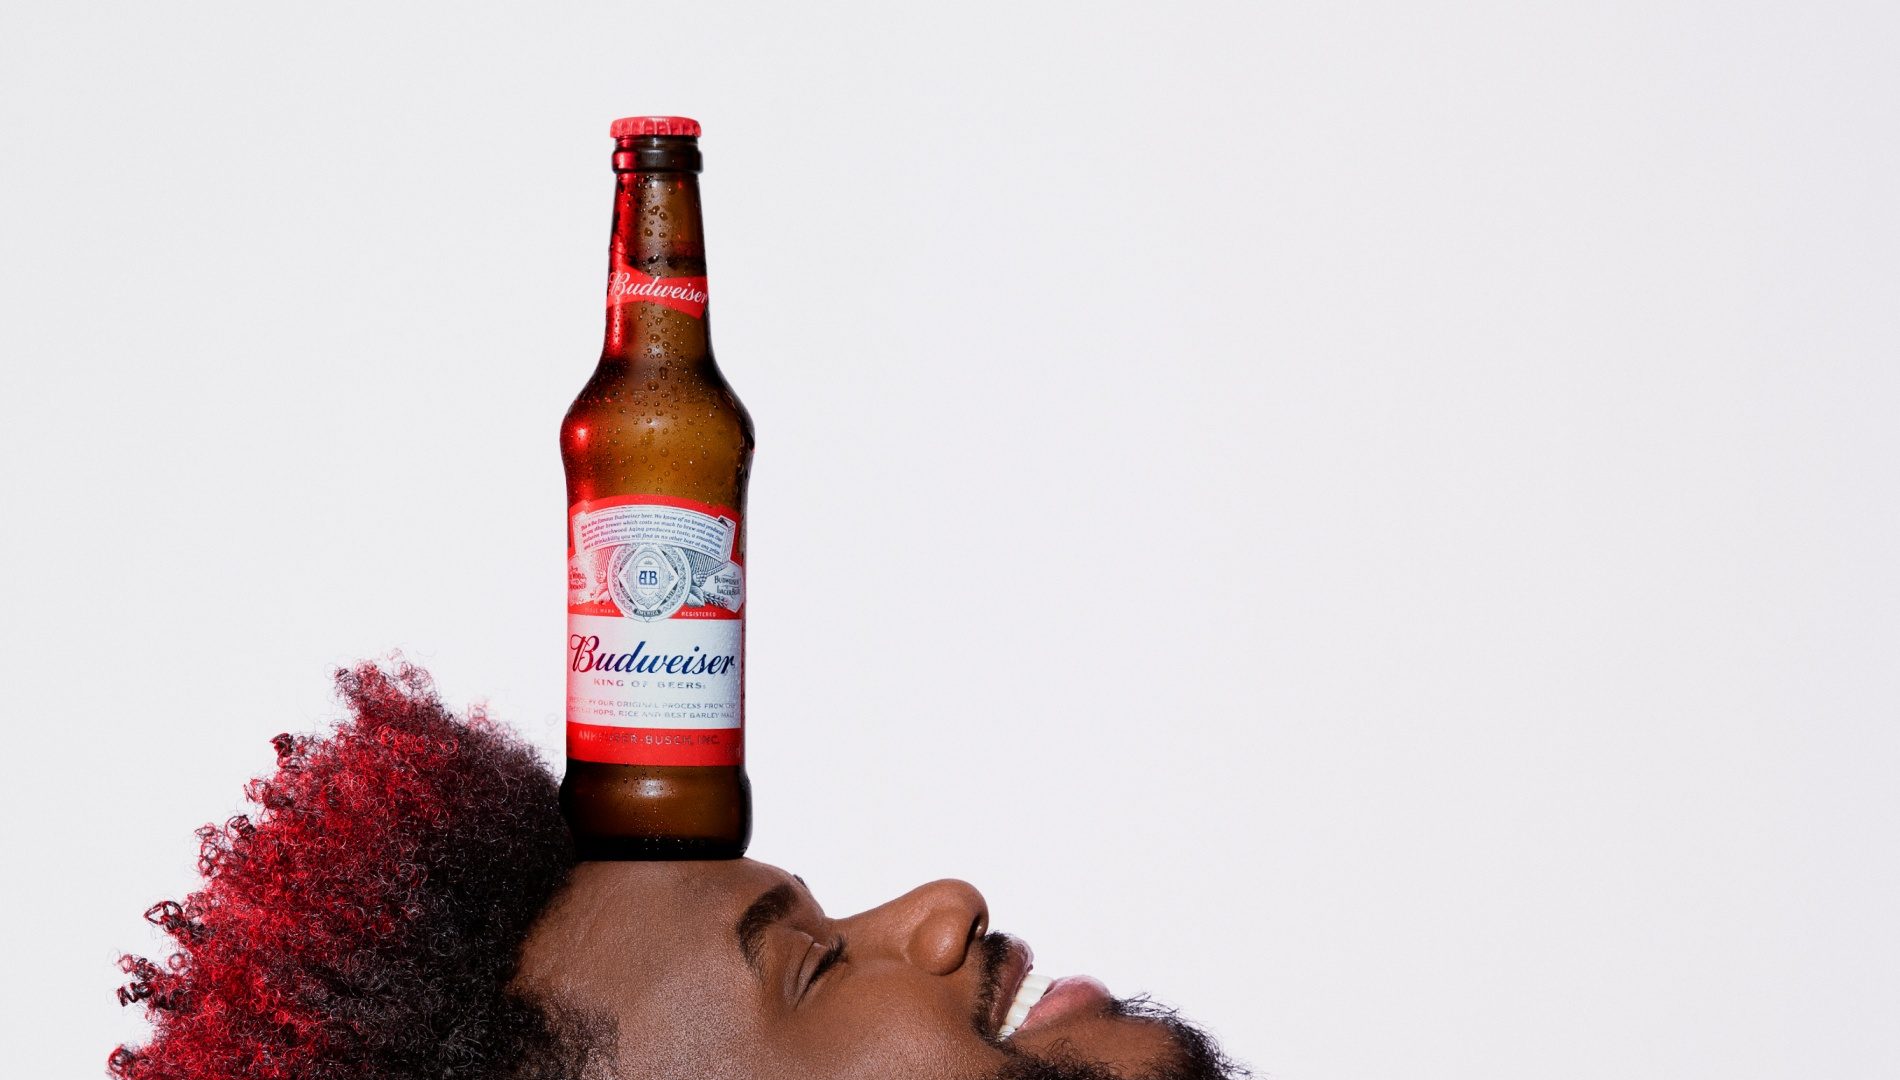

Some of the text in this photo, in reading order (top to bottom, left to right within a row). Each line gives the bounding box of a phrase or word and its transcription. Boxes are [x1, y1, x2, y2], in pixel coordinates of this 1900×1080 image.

[609, 272, 708, 304] Budweiser
[638, 570, 658, 586] AB
[570, 634, 735, 674] Budweiser
[593, 678, 624, 686] KING
[631, 680, 648, 688] OF
